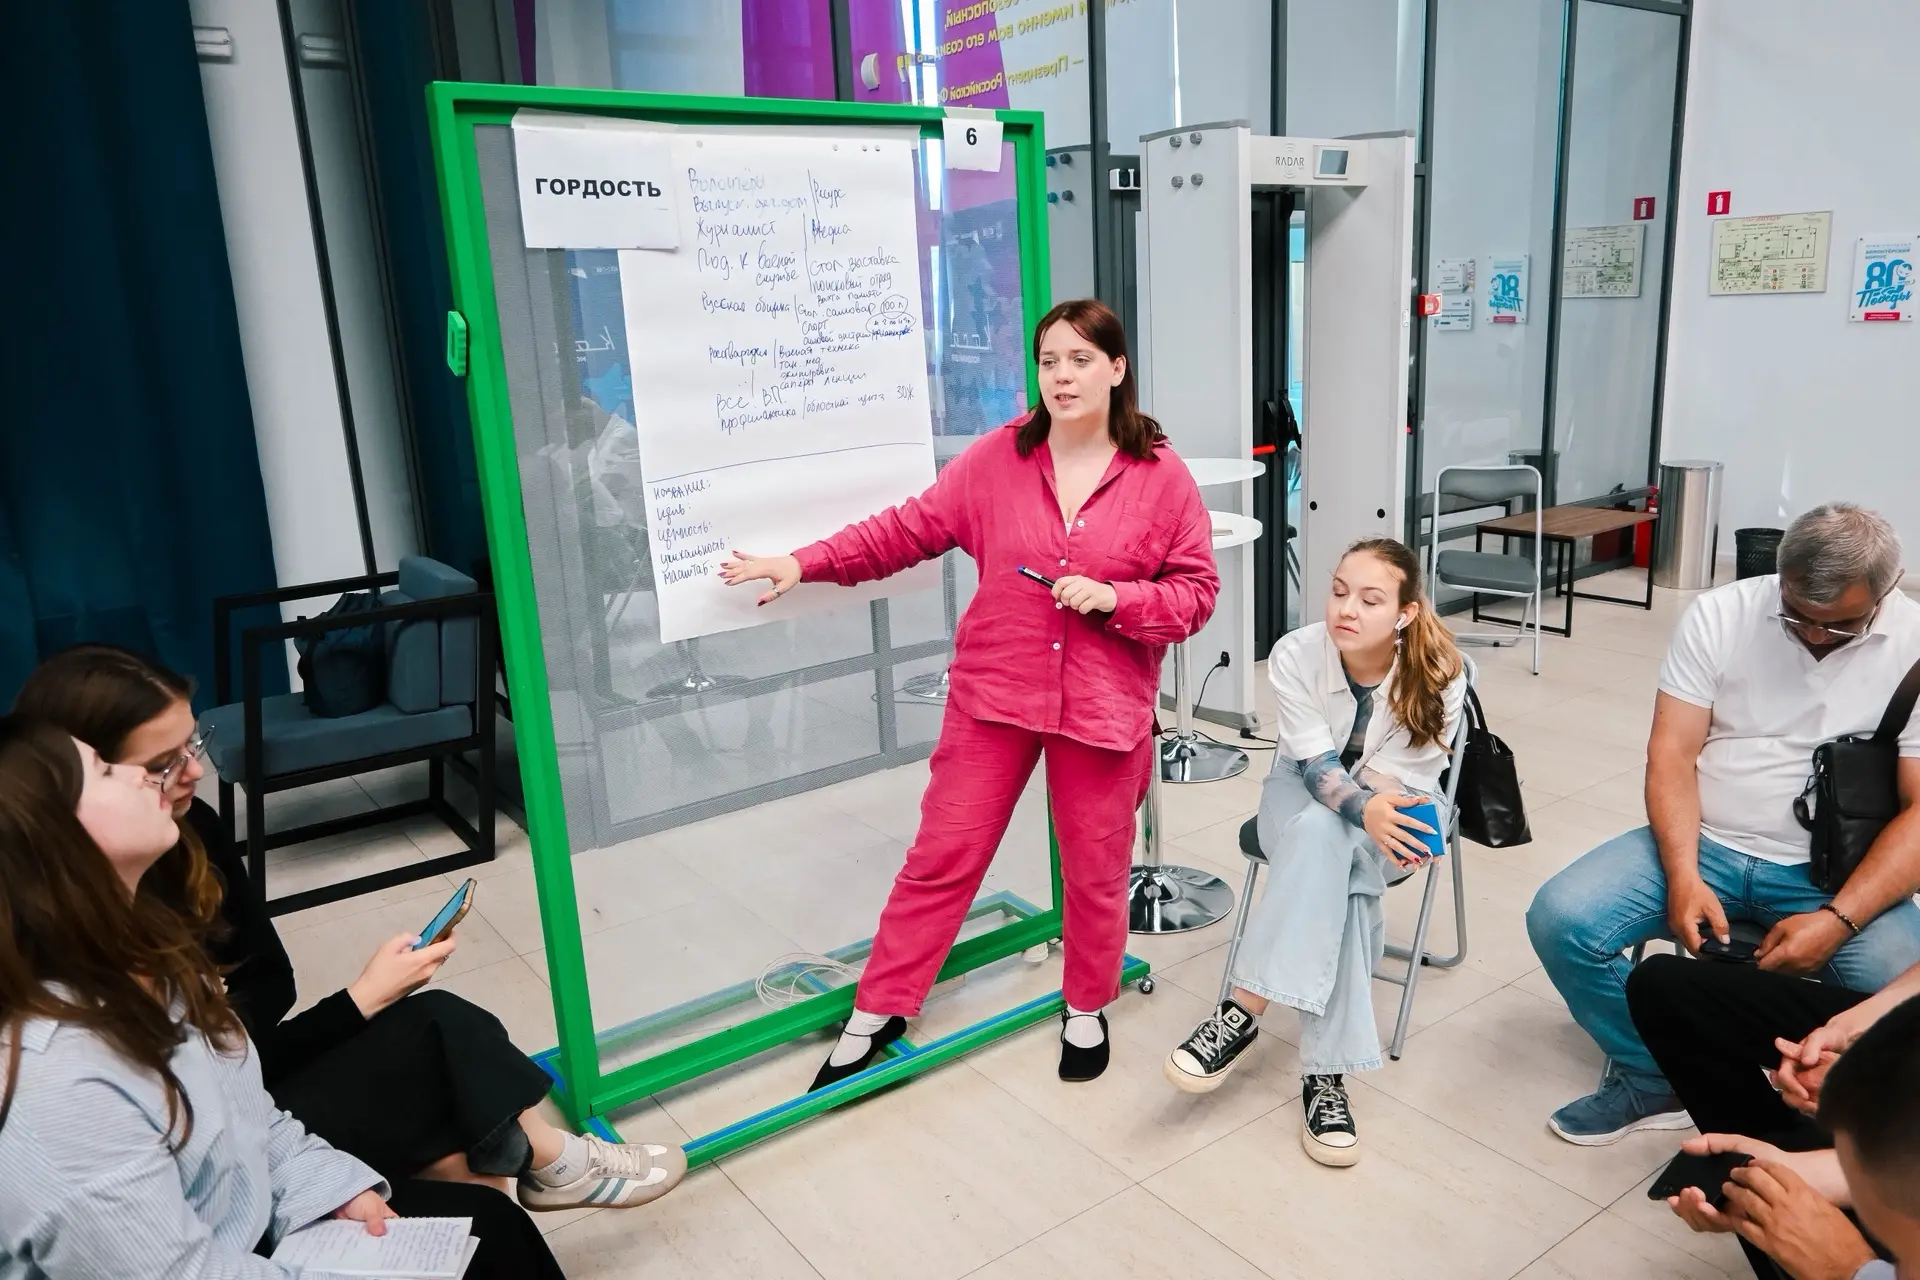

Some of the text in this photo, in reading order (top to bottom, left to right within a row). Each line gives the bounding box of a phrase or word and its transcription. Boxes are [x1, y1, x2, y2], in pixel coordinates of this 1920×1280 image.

[966, 128, 977, 145] 6
[1276, 157, 1305, 166] RADAR
[536, 178, 661, 199] ГОРДОСТЬ
